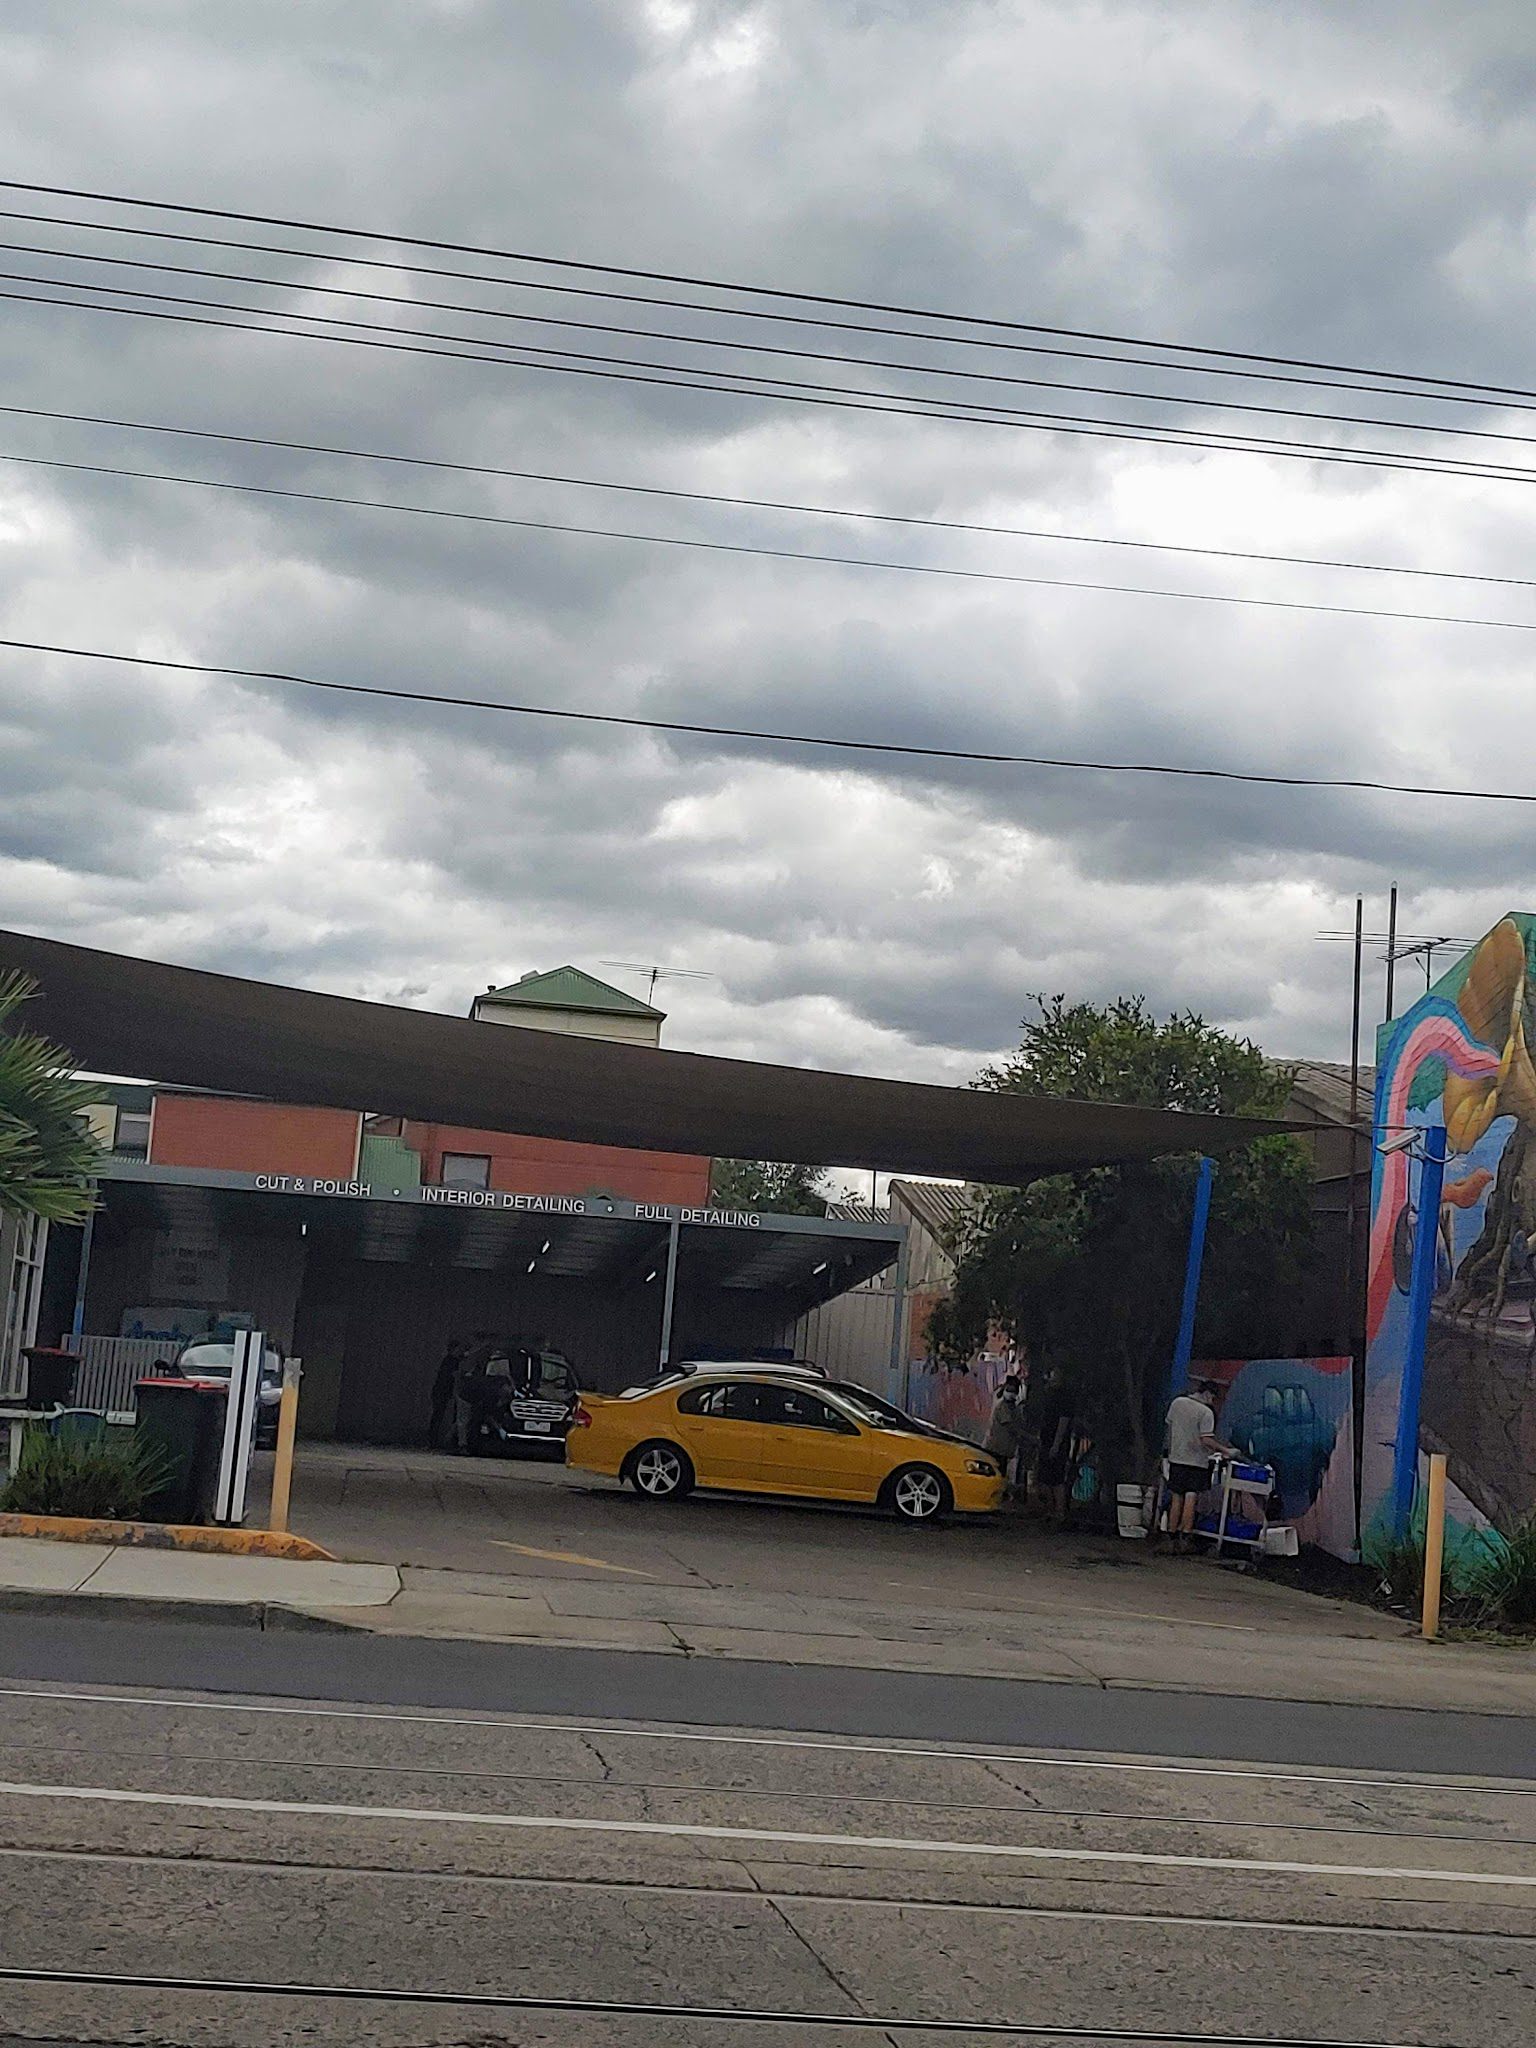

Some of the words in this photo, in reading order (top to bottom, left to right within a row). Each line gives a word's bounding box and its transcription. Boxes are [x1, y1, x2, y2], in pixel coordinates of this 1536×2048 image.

[255, 1175, 290, 1190] CUT
[293, 1178, 305, 1192] &
[313, 1180, 372, 1197] POLISH
[421, 1187, 496, 1207] INTERIOR
[502, 1194, 585, 1213] DETAILING
[634, 1204, 672, 1221] FULL
[680, 1209, 761, 1227] DETAILING
